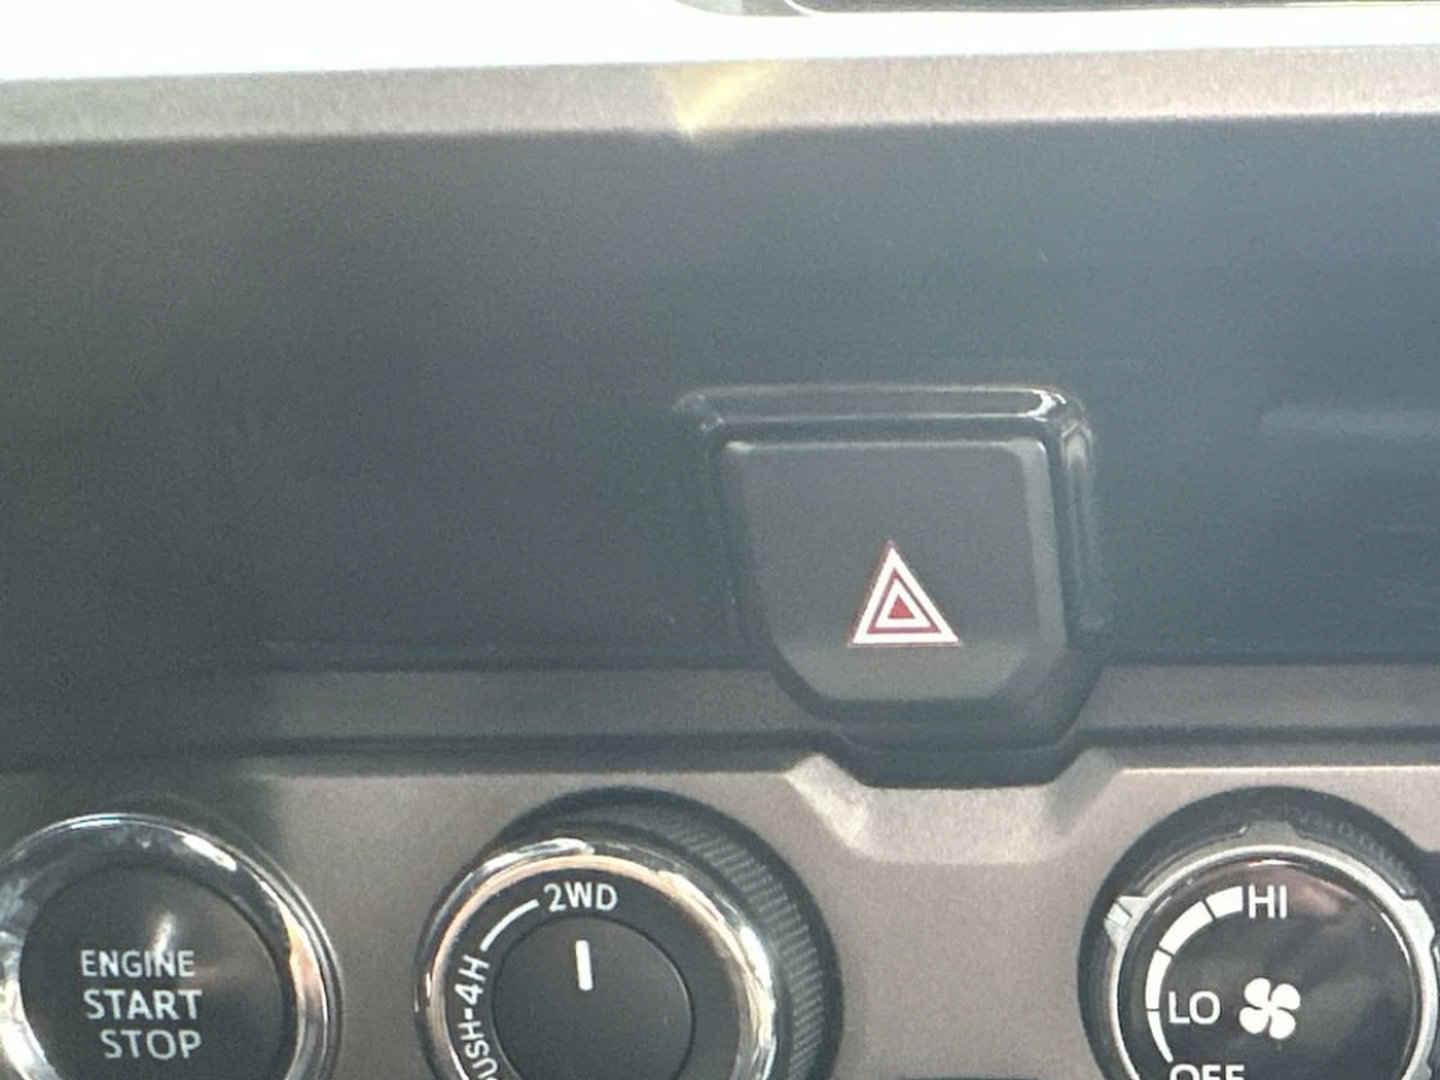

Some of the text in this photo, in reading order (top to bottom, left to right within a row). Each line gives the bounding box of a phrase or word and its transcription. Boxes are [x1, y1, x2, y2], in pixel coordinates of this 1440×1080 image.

[543, 881, 618, 912] 2WD
[1247, 884, 1288, 920] HI
[80, 950, 196, 978] ENGINE
[83, 988, 203, 1021] START
[1167, 990, 1221, 1025] LO
[100, 1029, 202, 1060] STOP
